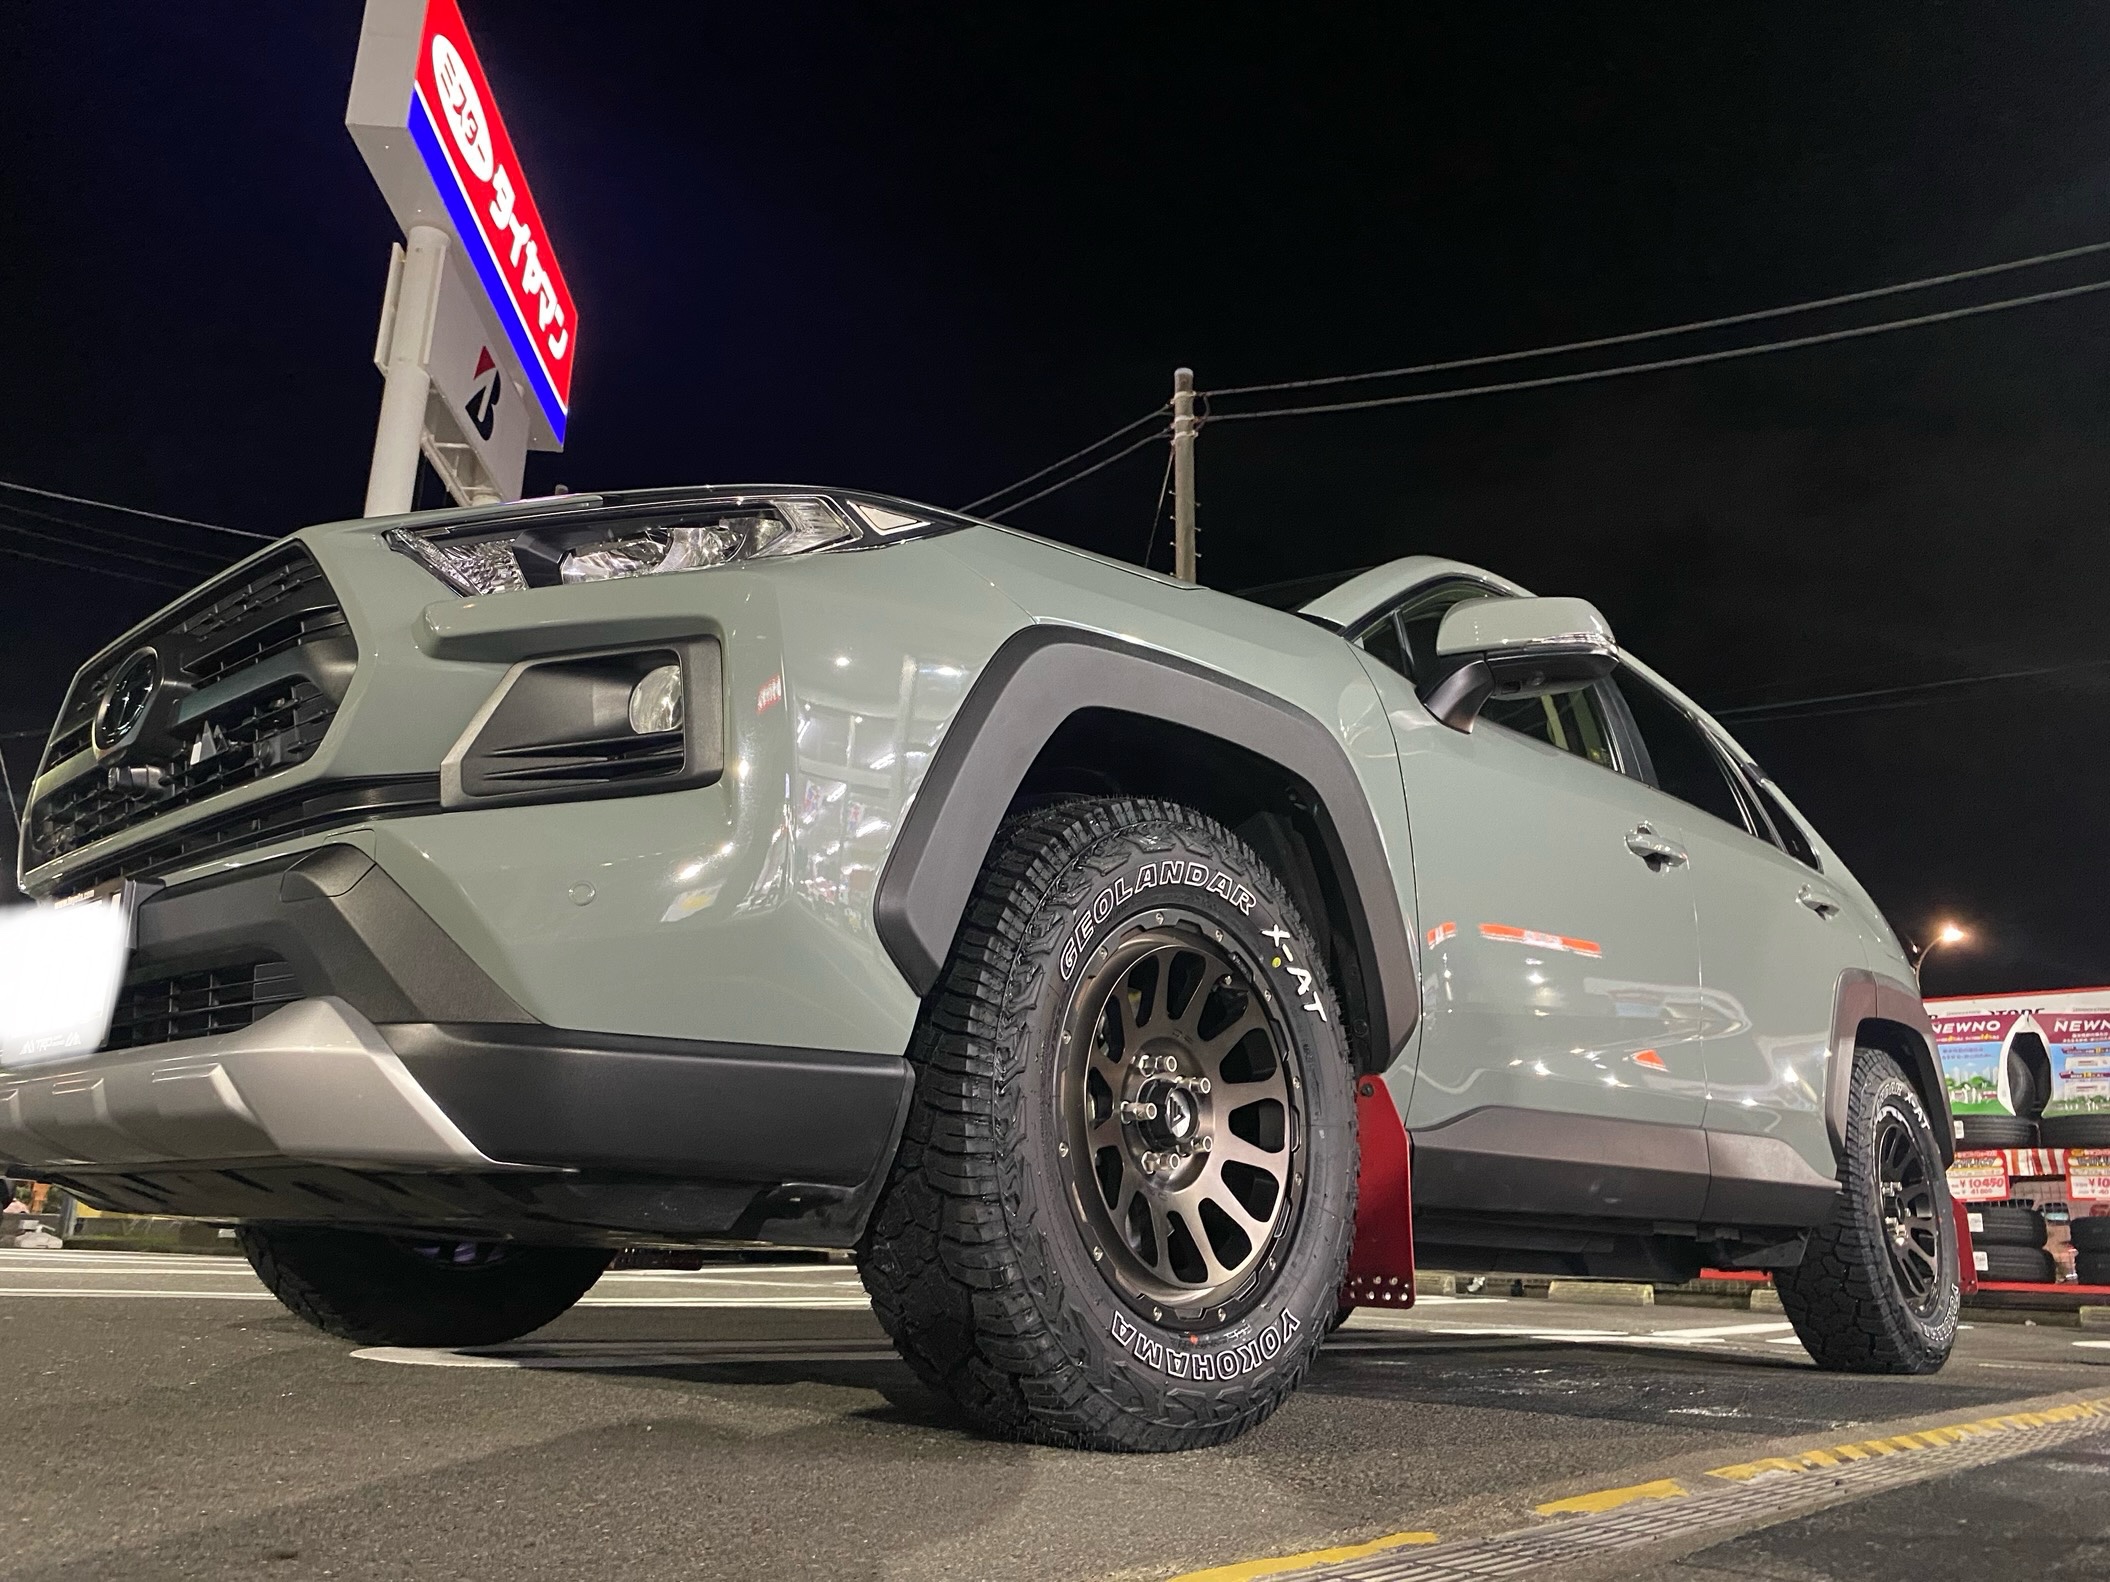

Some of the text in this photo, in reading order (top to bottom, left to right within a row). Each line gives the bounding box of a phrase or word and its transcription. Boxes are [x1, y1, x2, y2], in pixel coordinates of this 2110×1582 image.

[488, 163, 569, 361] タイヤマン
[1059, 860, 1328, 1022] GEOLANDAR X-AT
[1111, 1307, 1301, 1381] YOKOHAMA
